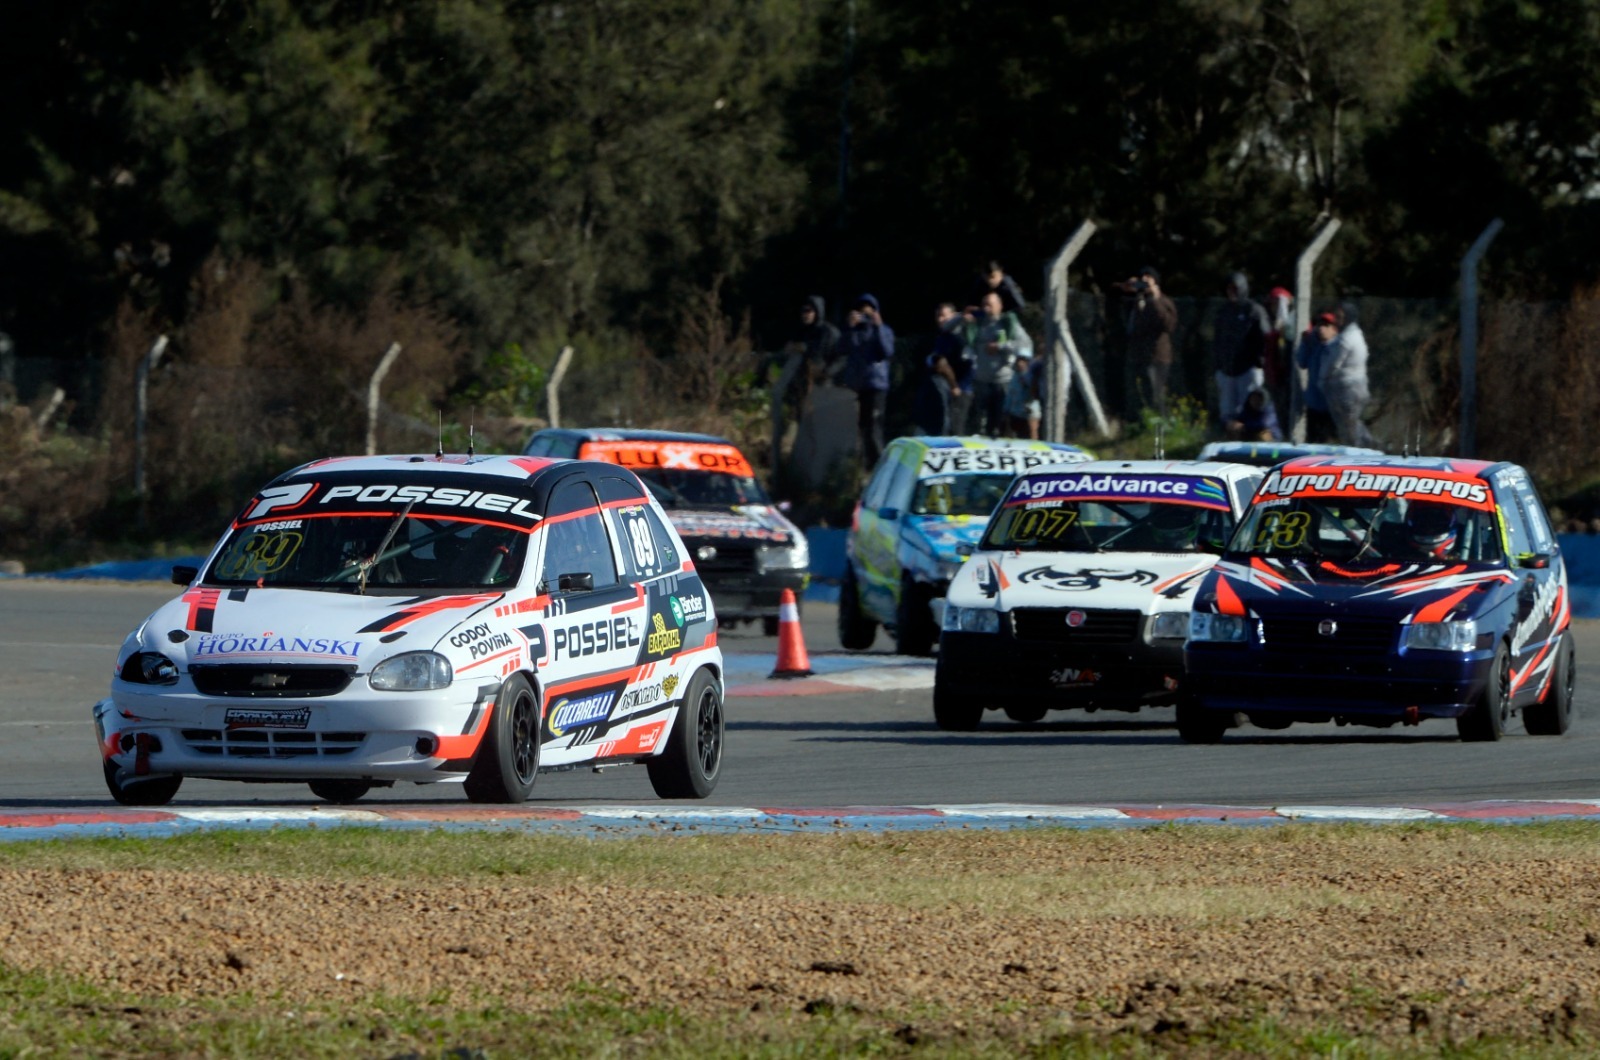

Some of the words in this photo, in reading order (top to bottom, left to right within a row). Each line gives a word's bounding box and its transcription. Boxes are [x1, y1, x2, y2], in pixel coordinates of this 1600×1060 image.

[614, 449, 743, 471] LUXOR
[1013, 475, 1188, 498] AgroAdvance
[1259, 469, 1336, 496] Agro
[1336, 469, 1488, 503] Pamperos
[319, 485, 543, 520] POSSIEL
[253, 520, 303, 533] POSSIEL
[1007, 508, 1078, 543] 107
[220, 532, 303, 577] 89
[628, 517, 655, 568] 89
[194, 636, 364, 657] HORIANSKI
[200, 632, 245, 641] GRUPO
[450, 622, 492, 648] GODOY
[469, 632, 513, 659] POVIÑA
[553, 616, 640, 661] POSSIEL
[649, 630, 679, 652] BARDAHL
[553, 693, 616, 729] CICCARELLI
